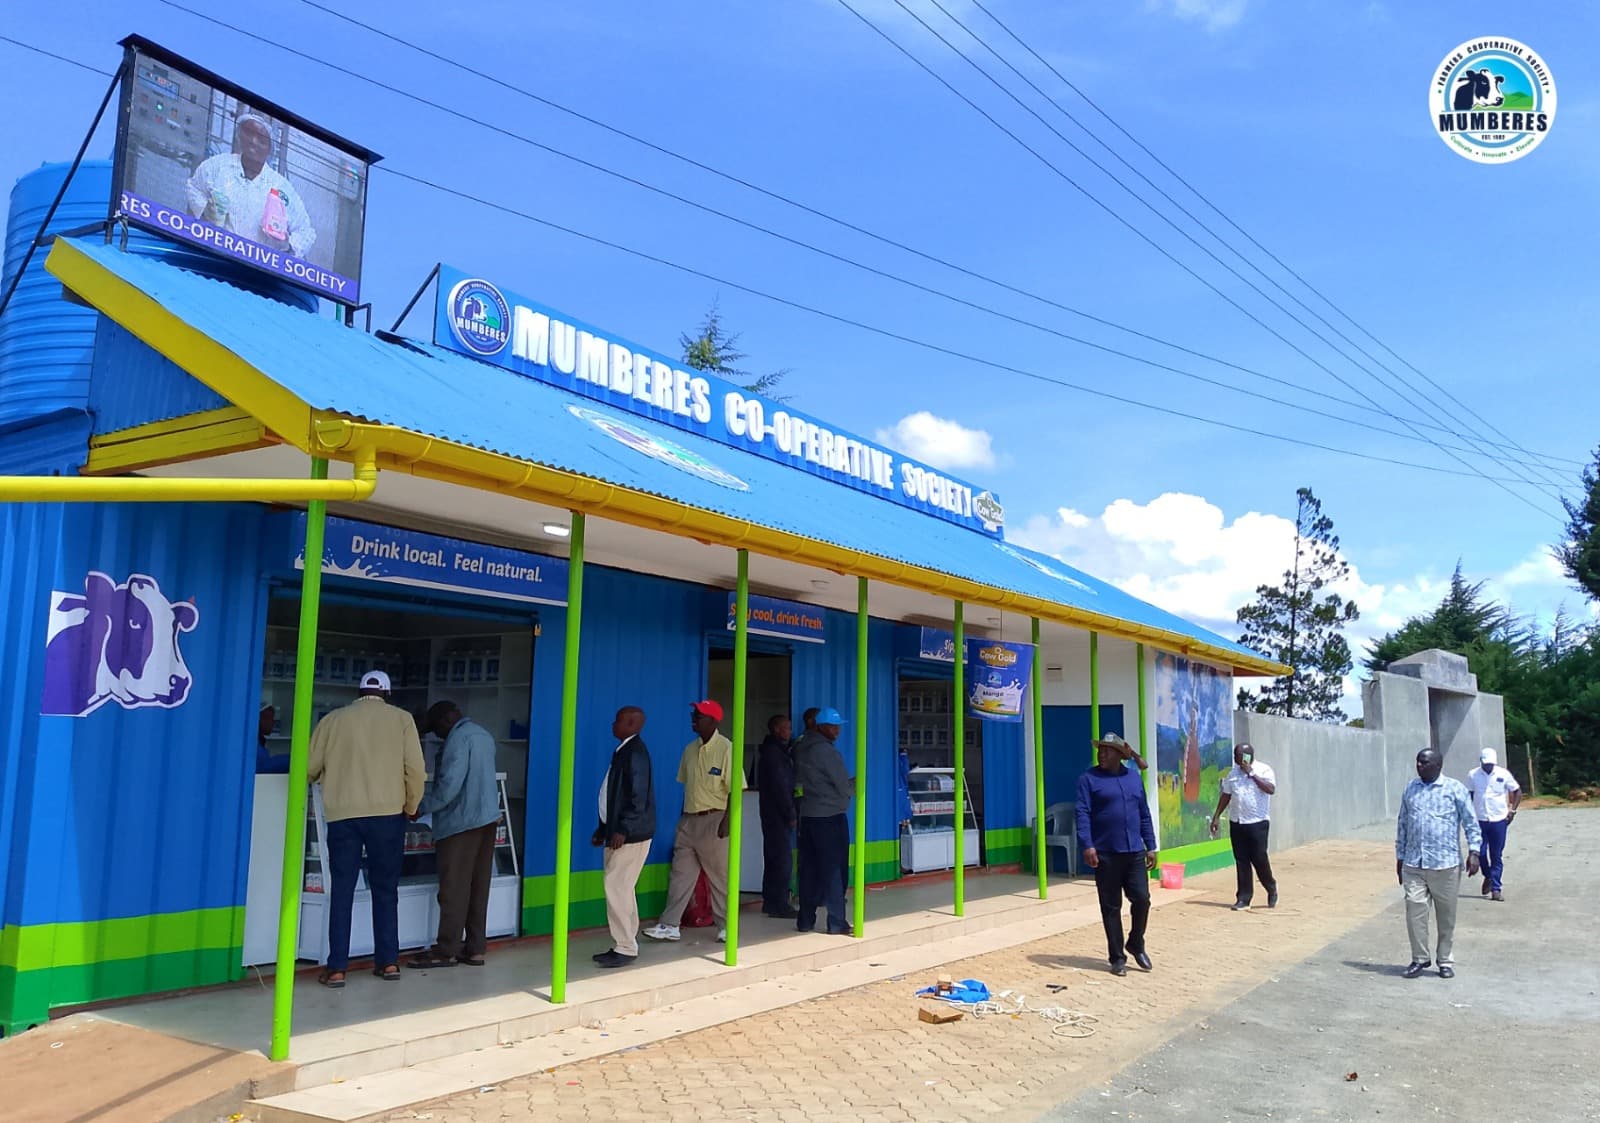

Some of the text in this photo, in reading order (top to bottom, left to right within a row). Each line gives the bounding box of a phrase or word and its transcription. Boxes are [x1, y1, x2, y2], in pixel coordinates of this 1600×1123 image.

[157, 210, 279, 269] CO-OPERATIVE
[284, 260, 347, 293] SOCIETY
[455, 317, 507, 344] MUMBERES
[511, 305, 972, 518] MUMBERES CO-OPERATIVE SOCIETY
[351, 535, 542, 583] Drink local. Feel natural.
[753, 609, 775, 625] cool,
[776, 611, 800, 626] drink
[980, 650, 1017, 664] Cow Gold
